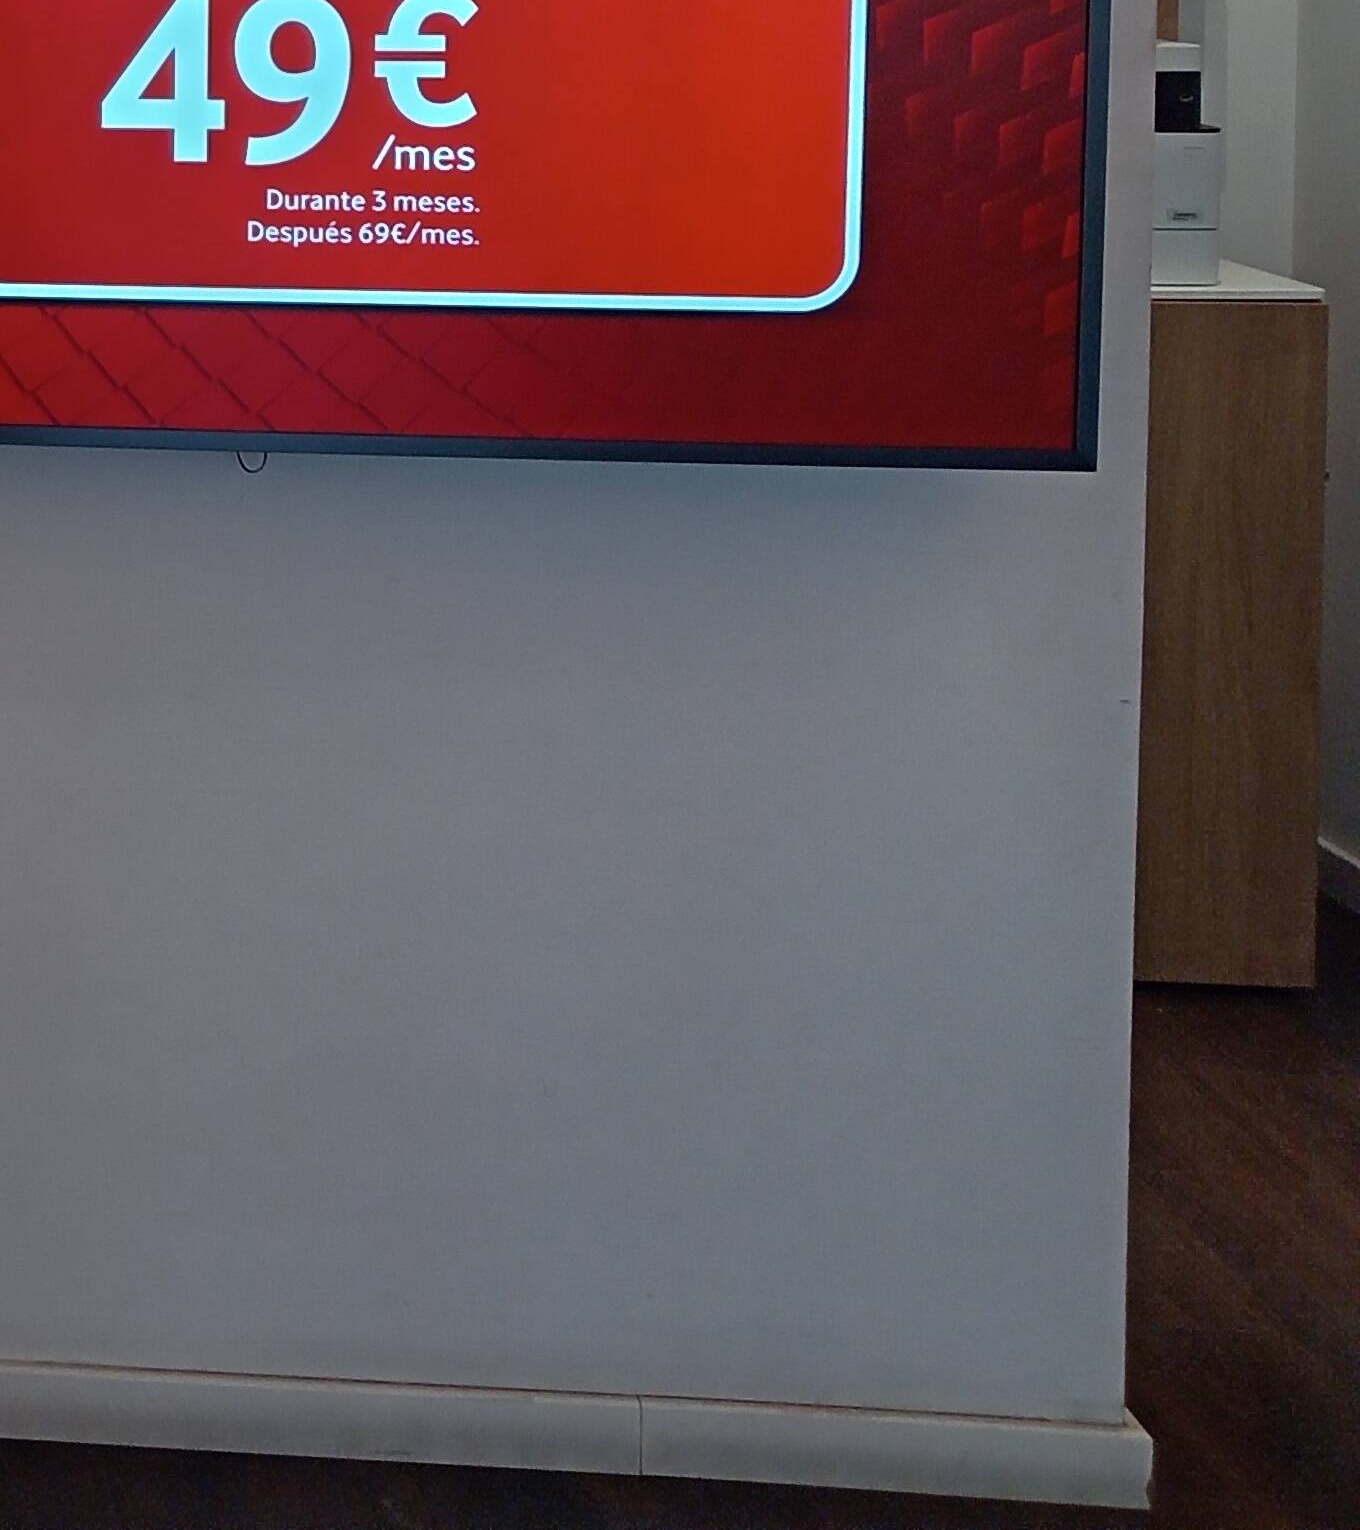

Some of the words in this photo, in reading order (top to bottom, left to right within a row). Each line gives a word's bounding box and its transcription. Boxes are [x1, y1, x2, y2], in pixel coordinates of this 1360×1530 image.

[372, 134, 476, 171] /mes
[266, 188, 366, 212] Durante
[371, 190, 387, 212] 3
[393, 195, 480, 213] meses.
[247, 220, 353, 248] Después
[358, 221, 480, 246] 69€/mes.
